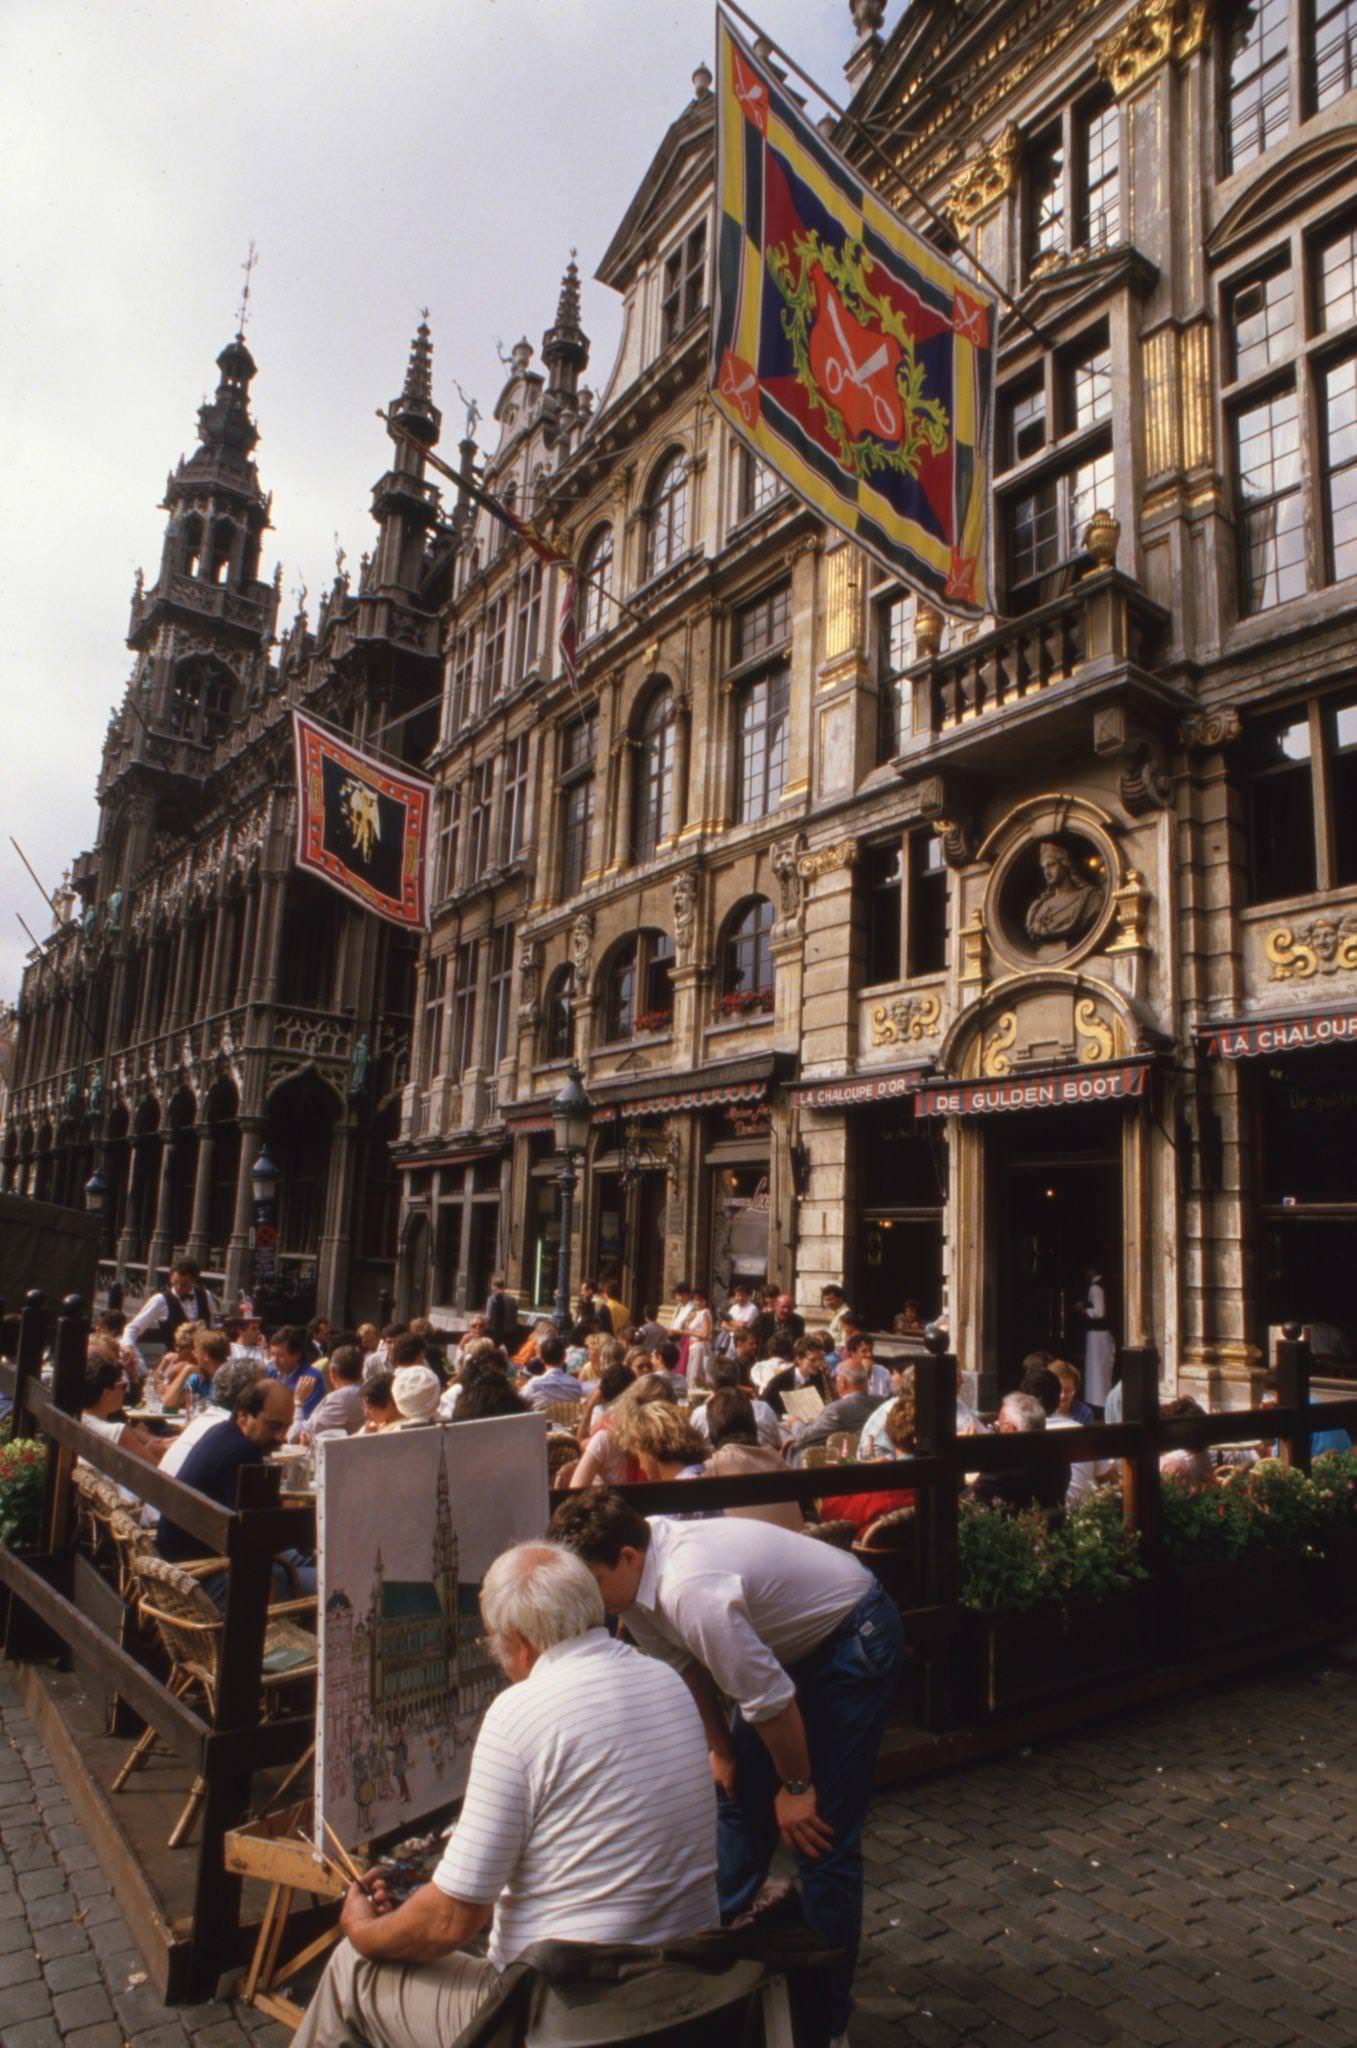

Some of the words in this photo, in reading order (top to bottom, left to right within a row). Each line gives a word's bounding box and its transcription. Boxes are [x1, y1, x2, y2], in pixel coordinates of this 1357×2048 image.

[1222, 1036, 1249, 1053] LA
[800, 1091, 813, 1105] LA
[817, 1084, 873, 1103] CHALOUPE
[878, 1078, 905, 1094] D'OR
[936, 1096, 959, 1110] DE
[972, 1086, 1052, 1107] GULDEN
[1063, 1077, 1120, 1098] BOOT
